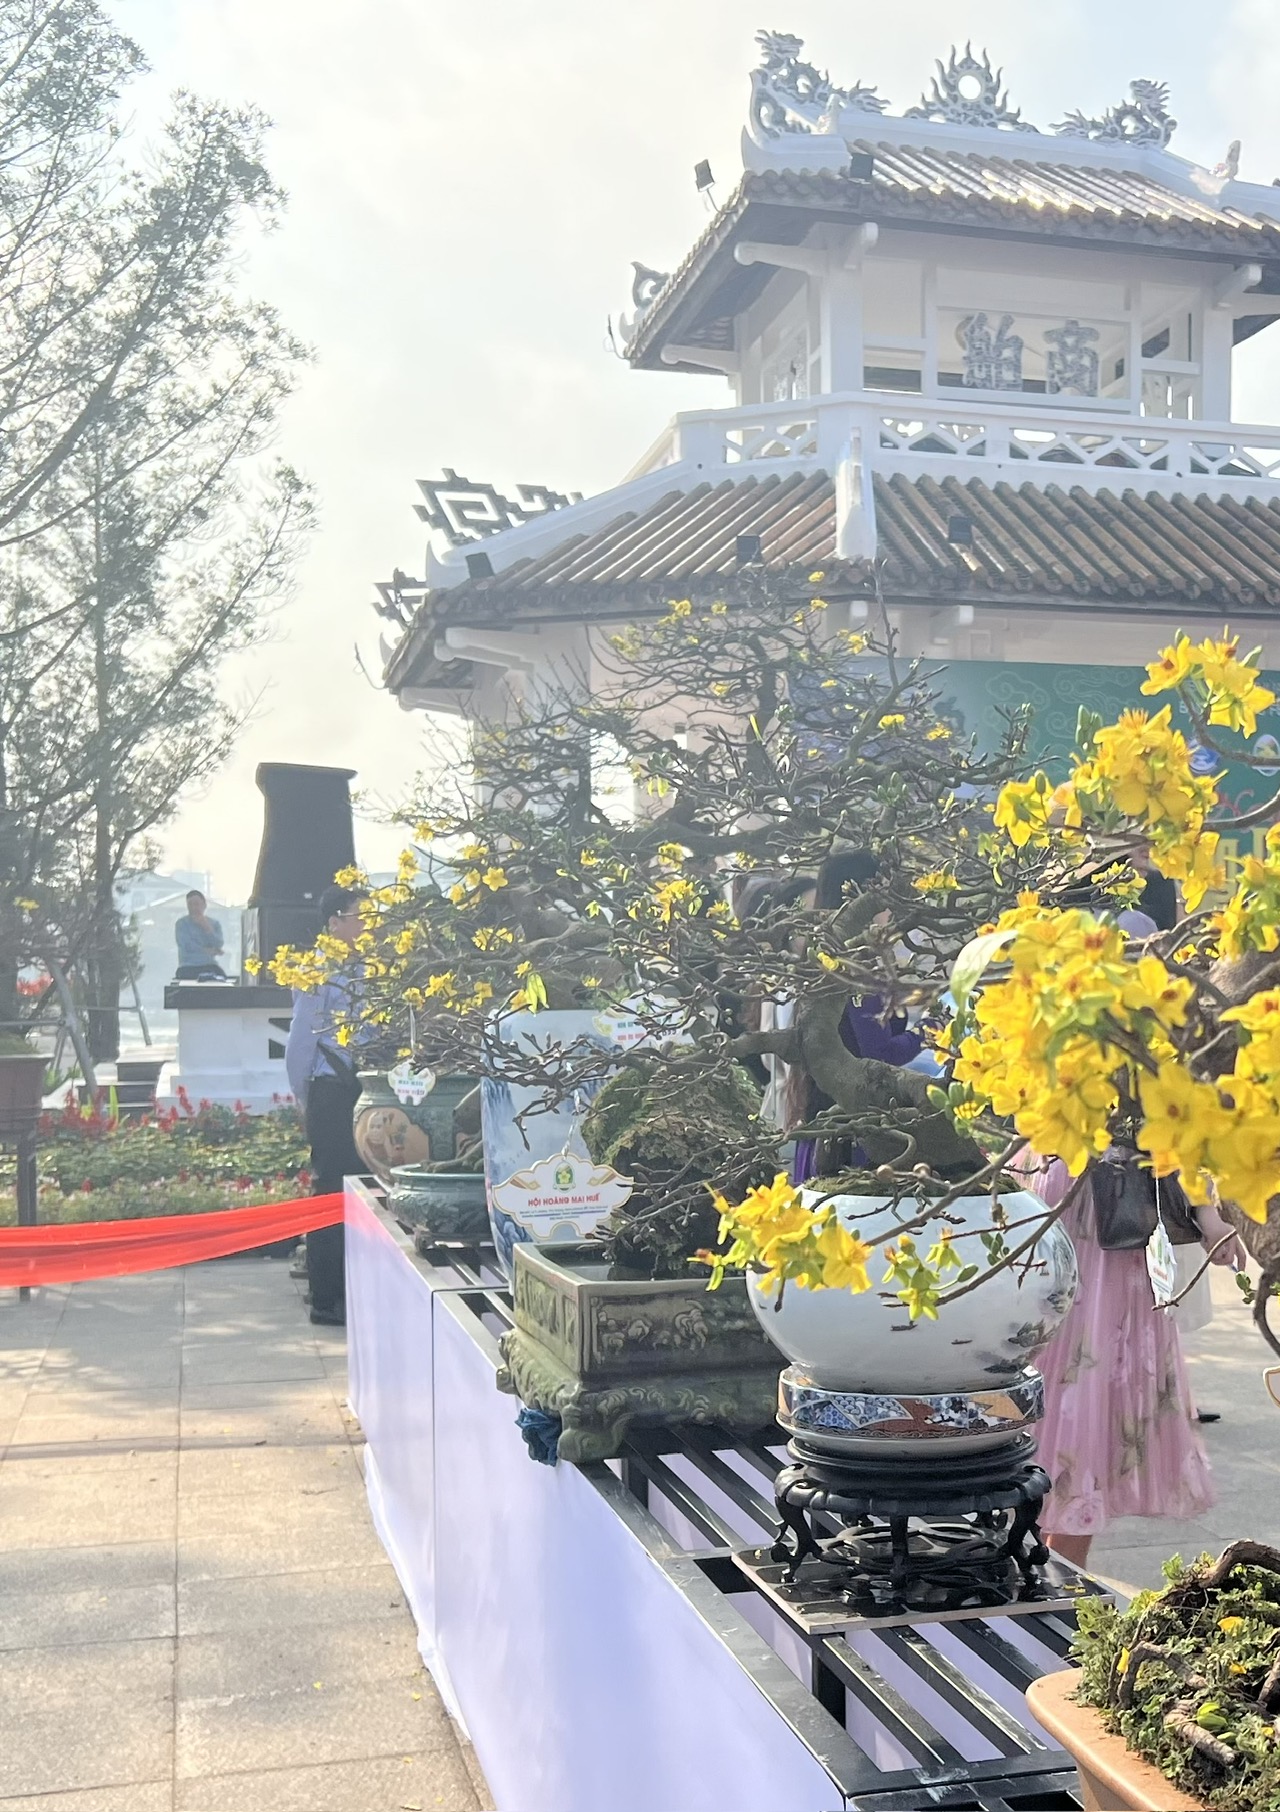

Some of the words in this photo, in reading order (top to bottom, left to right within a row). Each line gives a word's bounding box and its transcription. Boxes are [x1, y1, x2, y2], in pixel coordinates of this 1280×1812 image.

[528, 1197, 541, 1207] HỘI
[571, 1196, 585, 1204] MAI
[586, 1193, 600, 1201] HUẾ
